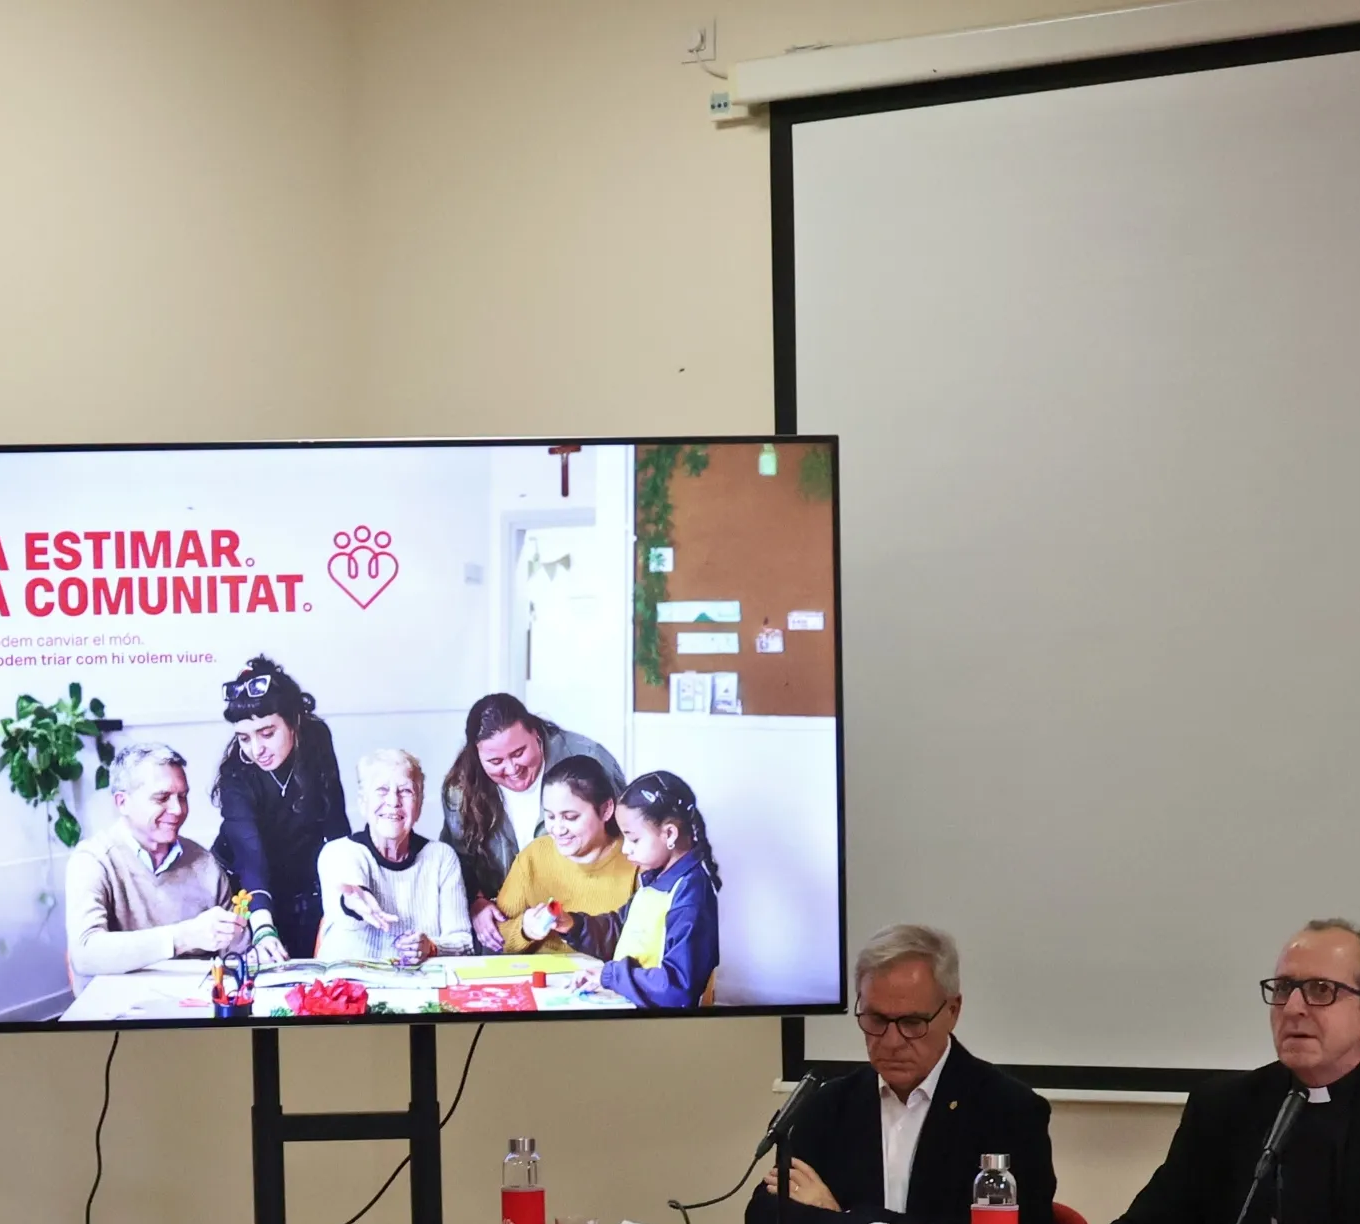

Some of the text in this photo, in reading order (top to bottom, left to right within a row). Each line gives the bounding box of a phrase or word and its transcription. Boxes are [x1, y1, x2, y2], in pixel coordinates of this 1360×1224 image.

[36, 633, 89, 647] canviar
[92, 633, 106, 647] el
[109, 632, 145, 647] món.
[41, 652, 72, 666] triar
[75, 654, 108, 665] com
[111, 652, 125, 665] hi
[128, 651, 173, 665] volem
[177, 650, 218, 664] viure.
